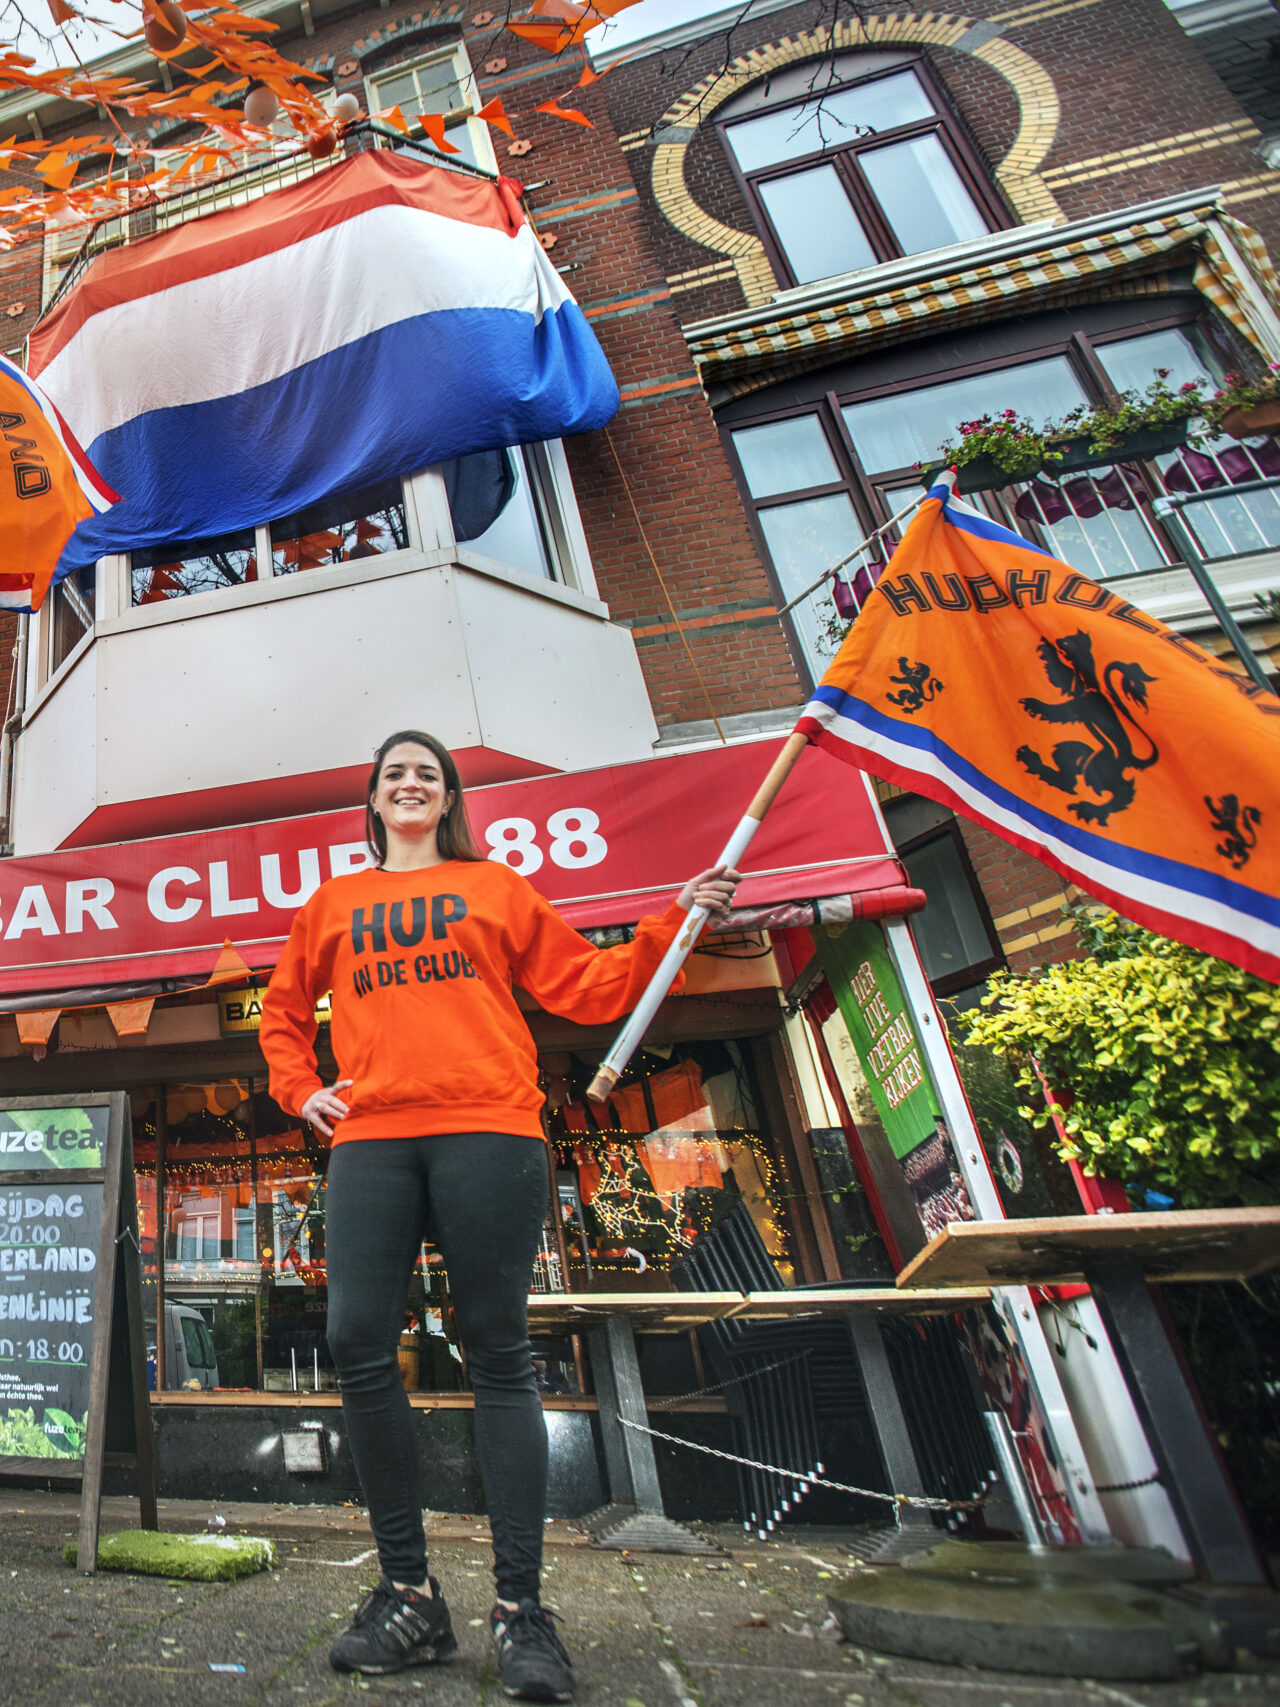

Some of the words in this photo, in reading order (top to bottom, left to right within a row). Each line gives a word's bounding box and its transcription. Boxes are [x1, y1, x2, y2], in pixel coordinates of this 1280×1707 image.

[875, 571, 1012, 616] HUP
[351, 893, 468, 955] HUP
[353, 964, 373, 998] IN
[377, 959, 408, 987] DE
[850, 960, 877, 1008] HIER
[226, 1000, 262, 1021] BA
[863, 989, 892, 1040] LIVE
[881, 1047, 923, 1110] KIJKEN
[26, 1338, 83, 1363] 18:00
[12, 1383, 45, 1393] natuurlijk
[46, 1384, 59, 1392] wel
